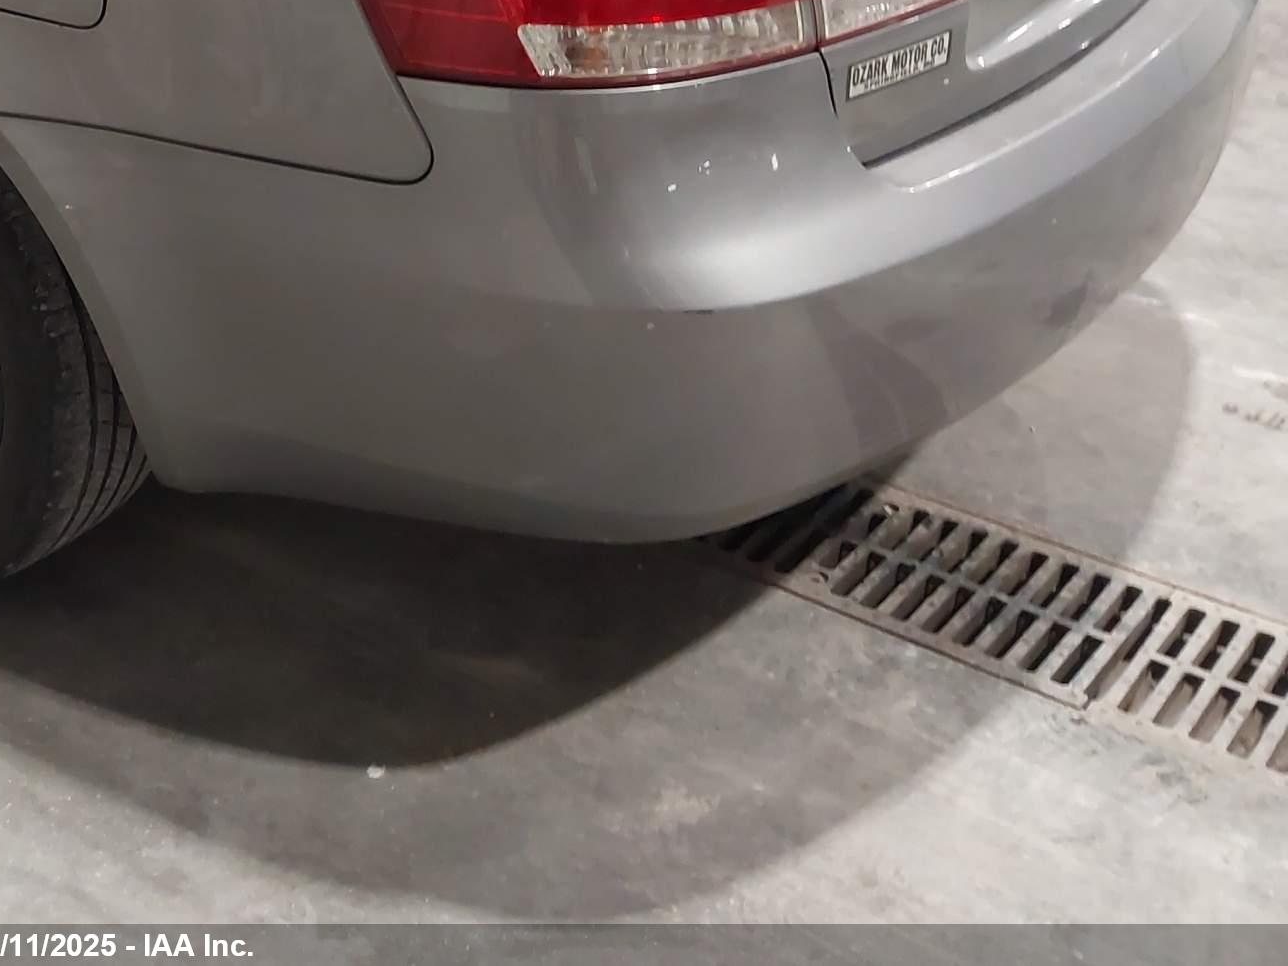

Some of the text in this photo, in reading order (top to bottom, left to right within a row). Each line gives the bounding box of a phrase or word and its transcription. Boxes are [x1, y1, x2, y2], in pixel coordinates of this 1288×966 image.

[852, 56, 889, 86] OZARK
[892, 41, 928, 73] MOTOR
[931, 36, 947, 57] CO.
